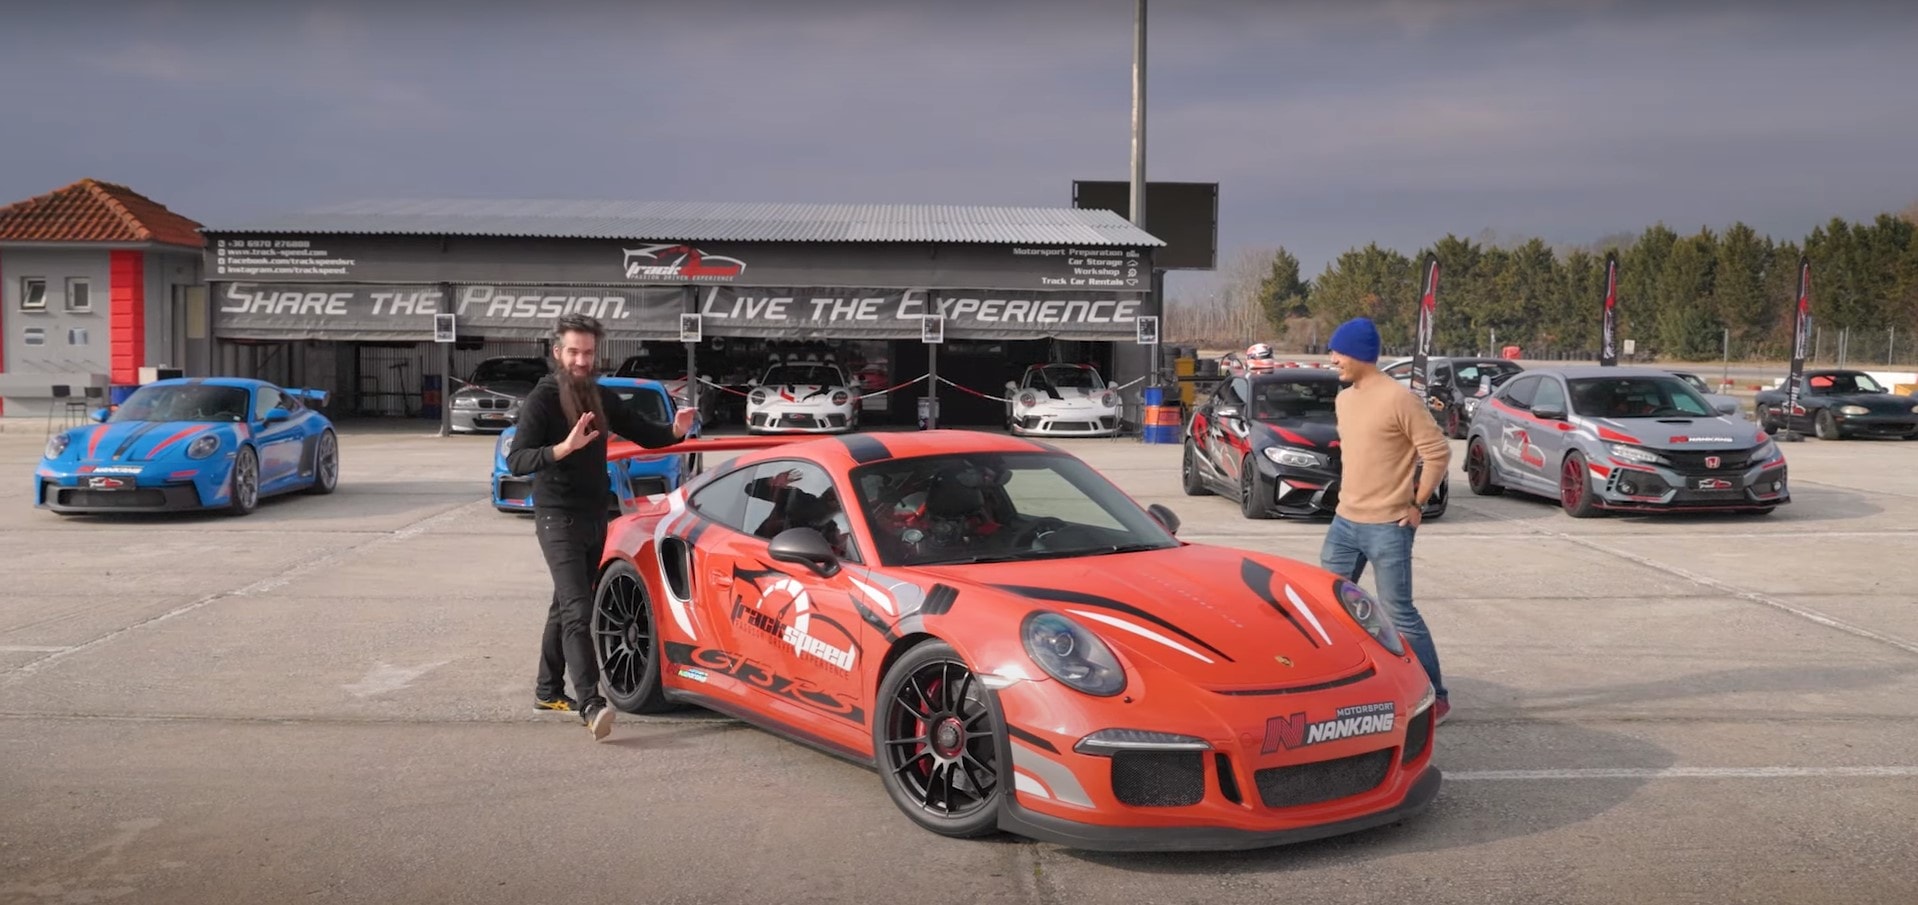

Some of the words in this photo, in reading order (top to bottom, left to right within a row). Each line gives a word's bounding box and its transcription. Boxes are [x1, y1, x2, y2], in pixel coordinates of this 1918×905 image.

[227, 249, 327, 257] www.track-speed.com
[1013, 248, 1065, 256] Motorsport
[1069, 249, 1123, 257] Preparation
[1087, 258, 1123, 267] Storage
[1074, 268, 1120, 276] Workshop
[1042, 277, 1067, 285] Track
[1088, 278, 1124, 286] Rentals
[1336, 702, 1394, 717] MOTORSPORT
[1307, 713, 1394, 744] NANKANG
